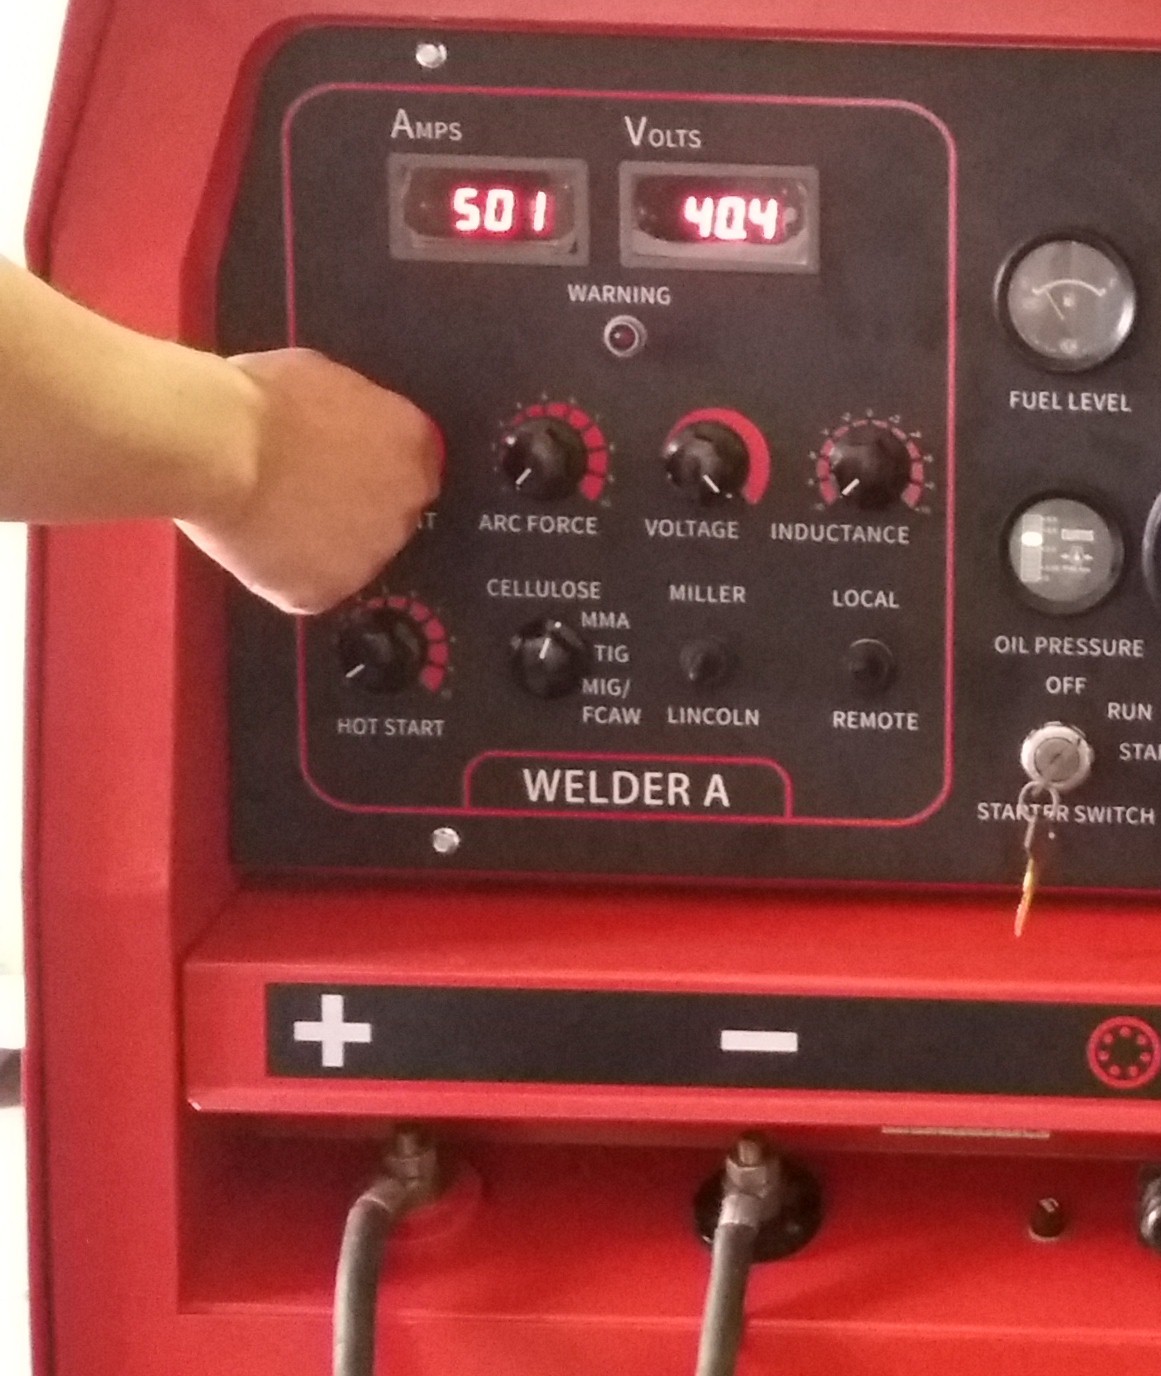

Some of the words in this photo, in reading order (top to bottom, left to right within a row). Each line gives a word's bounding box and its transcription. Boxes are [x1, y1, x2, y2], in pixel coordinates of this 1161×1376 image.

[453, 187, 547, 232] 501
[567, 284, 672, 306] WARNING
[1009, 390, 1062, 411] FUEL
[1067, 392, 1132, 412] LEVEL
[479, 514, 521, 533] ARC
[527, 514, 598, 536] FORCE
[644, 518, 739, 540] VOLTAGE
[770, 522, 910, 545] INDUCTANCE
[486, 578, 601, 600] CELLULOSE
[669, 584, 746, 604] MILLER
[832, 588, 900, 609] LOCAL
[581, 611, 631, 629] MMA
[594, 644, 630, 664] TIG
[994, 635, 1029, 654] OIL
[1034, 636, 1144, 658] PRESSURE
[582, 677, 631, 699] MIG/
[1045, 675, 1086, 695] OFF
[582, 705, 642, 725] FCAW
[667, 707, 760, 727] LINCOLN
[832, 710, 918, 731] REMOTE
[1107, 701, 1153, 721] RUN
[337, 717, 379, 736] HOT
[384, 718, 445, 737] START
[523, 768, 690, 806] WELDER
[703, 773, 730, 807] A
[976, 801, 1070, 822] STARTER
[1073, 804, 1155, 825] SWITCH
